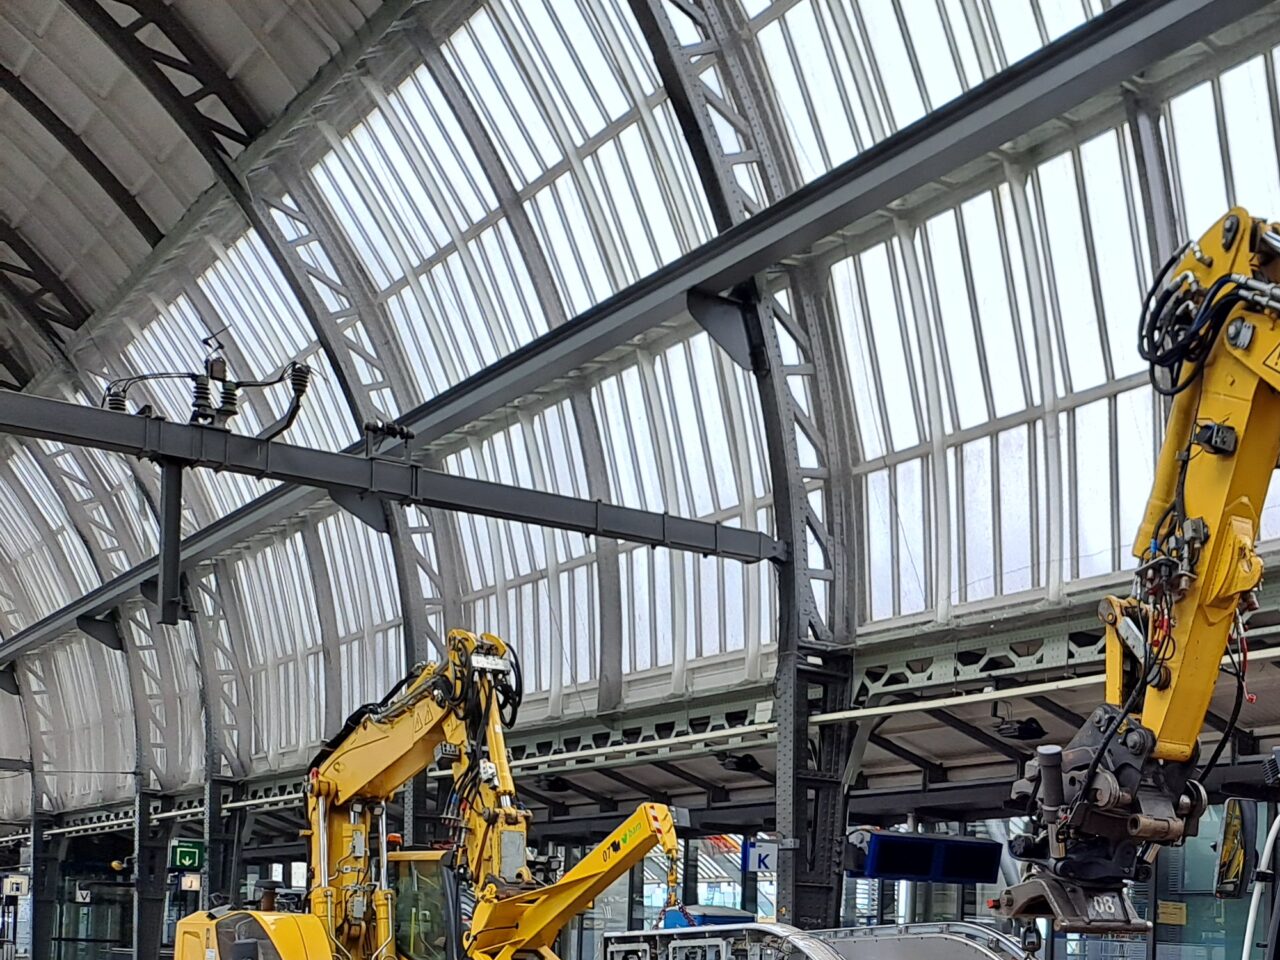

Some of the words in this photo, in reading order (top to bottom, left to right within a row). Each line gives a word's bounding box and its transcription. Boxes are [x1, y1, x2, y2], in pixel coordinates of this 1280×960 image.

[758, 853, 770, 870] K
[80, 891, 89, 900] V
[1094, 896, 1115, 914] 08
